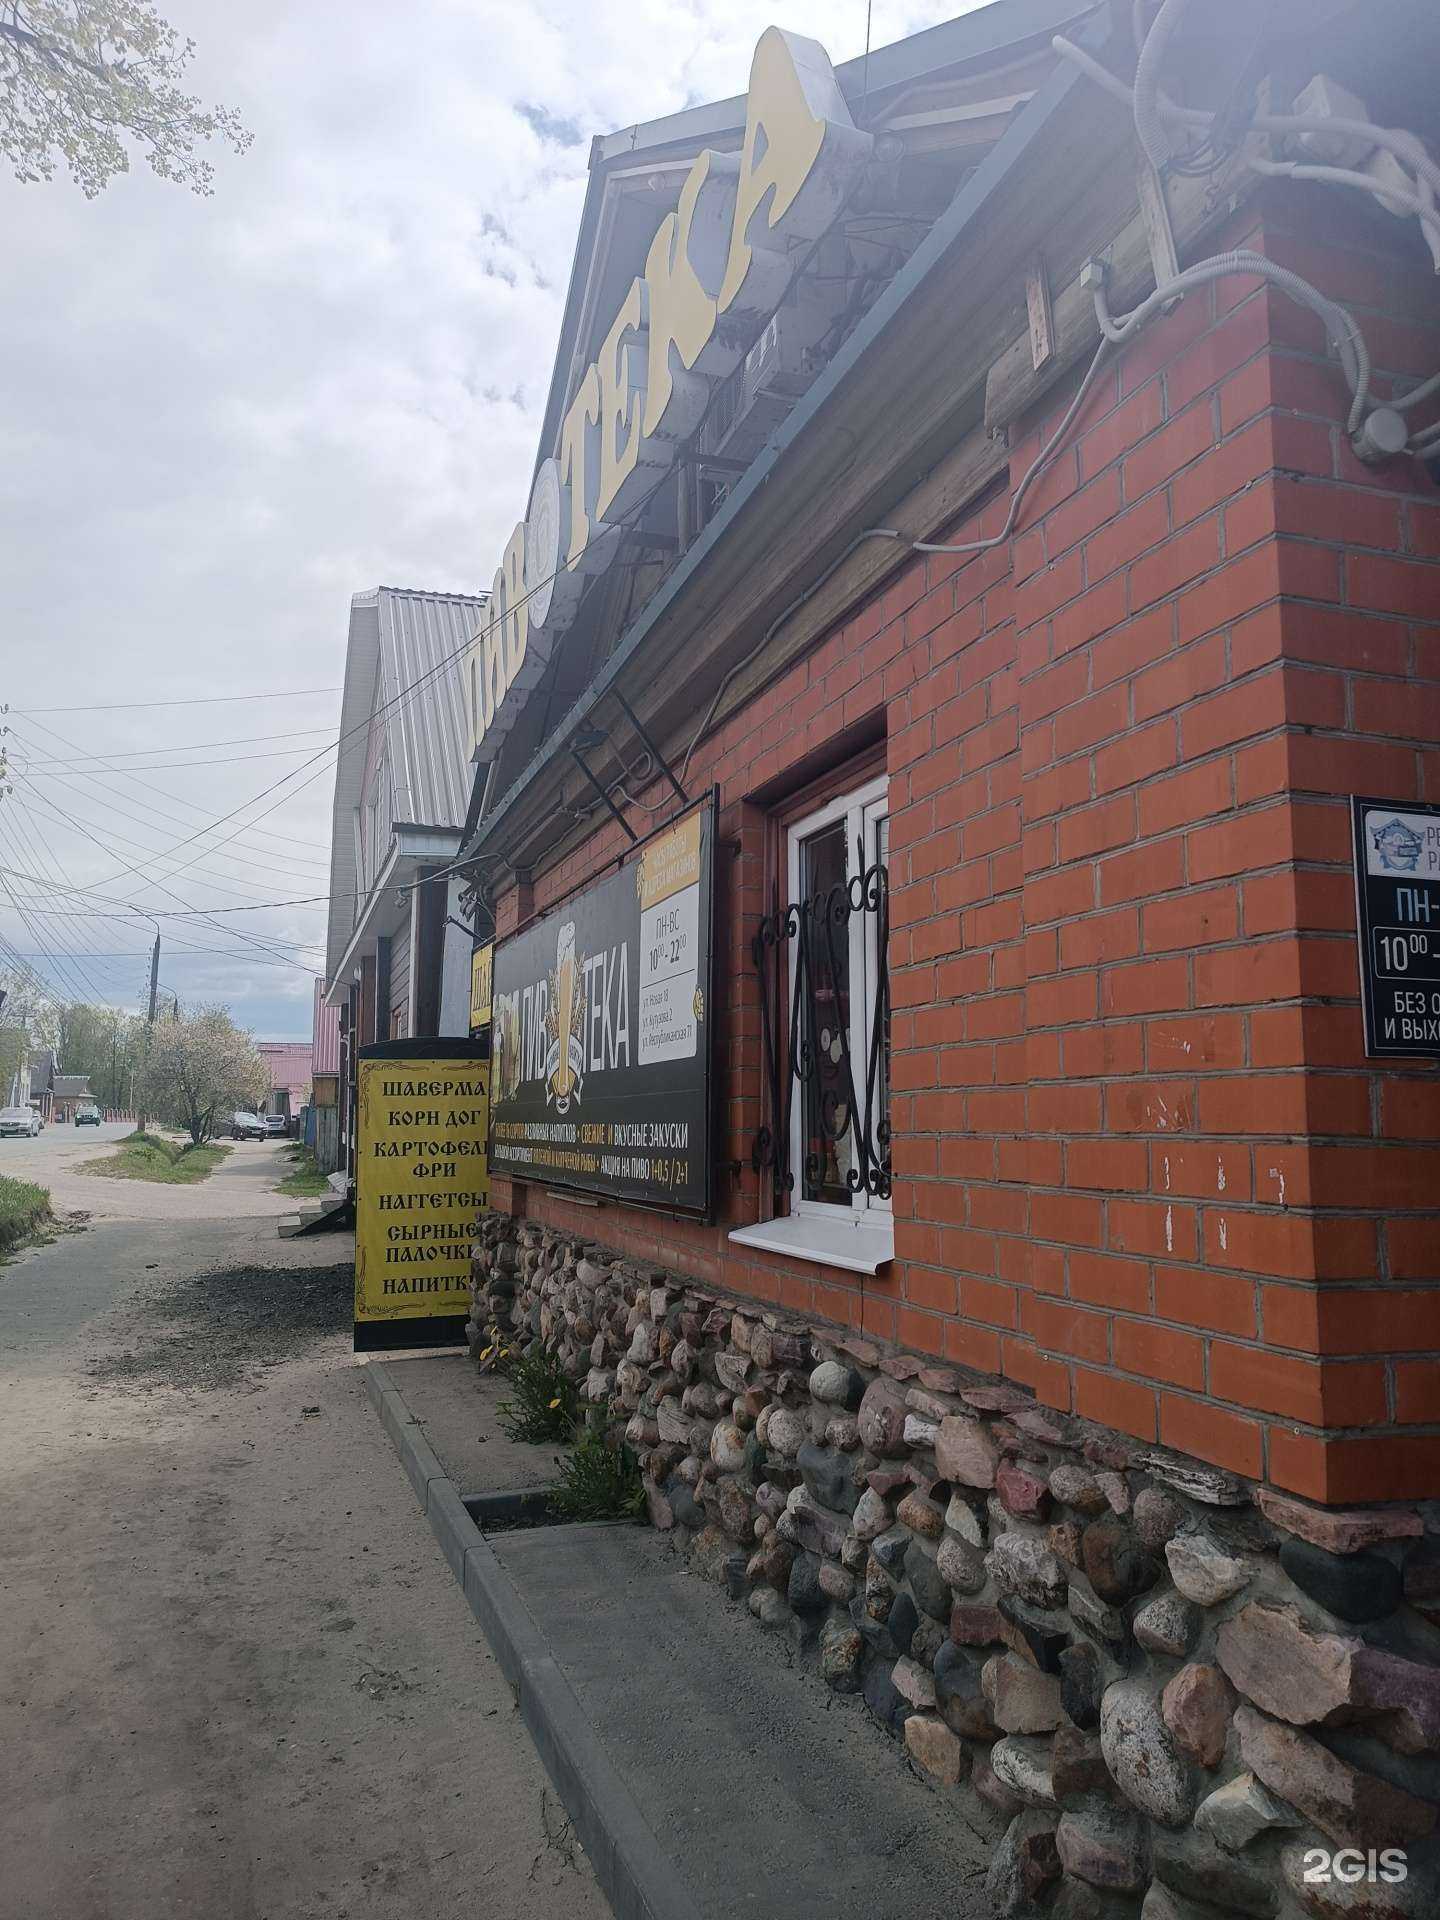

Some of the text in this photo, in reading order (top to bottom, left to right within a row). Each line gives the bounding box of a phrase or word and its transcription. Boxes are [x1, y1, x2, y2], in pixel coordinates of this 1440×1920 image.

[656, 908, 680, 940] ПН-ВС
[1394, 991, 1425, 1014] БЕЗ
[1384, 1017, 1440, 1041] И ВЫХ
[382, 1081, 487, 1097] ШАВЕРМА
[388, 1110, 481, 1129] КОРН ДОГ
[581, 1123, 605, 1145] СВЕЖИЕ
[607, 1123, 613, 1145] И
[614, 1123, 648, 1147] ВКУСНЫЕ
[648, 1122, 689, 1149] ЗАКУСКИ
[412, 1162, 457, 1178] ФРИ
[600, 1155, 620, 1180] АКЦИЯ
[621, 1157, 630, 1178] НА
[631, 1157, 650, 1180] ПИВО
[378, 1191, 489, 1211] НАГГЕТСЫ
[387, 1223, 477, 1242] СЫРНЫЕ
